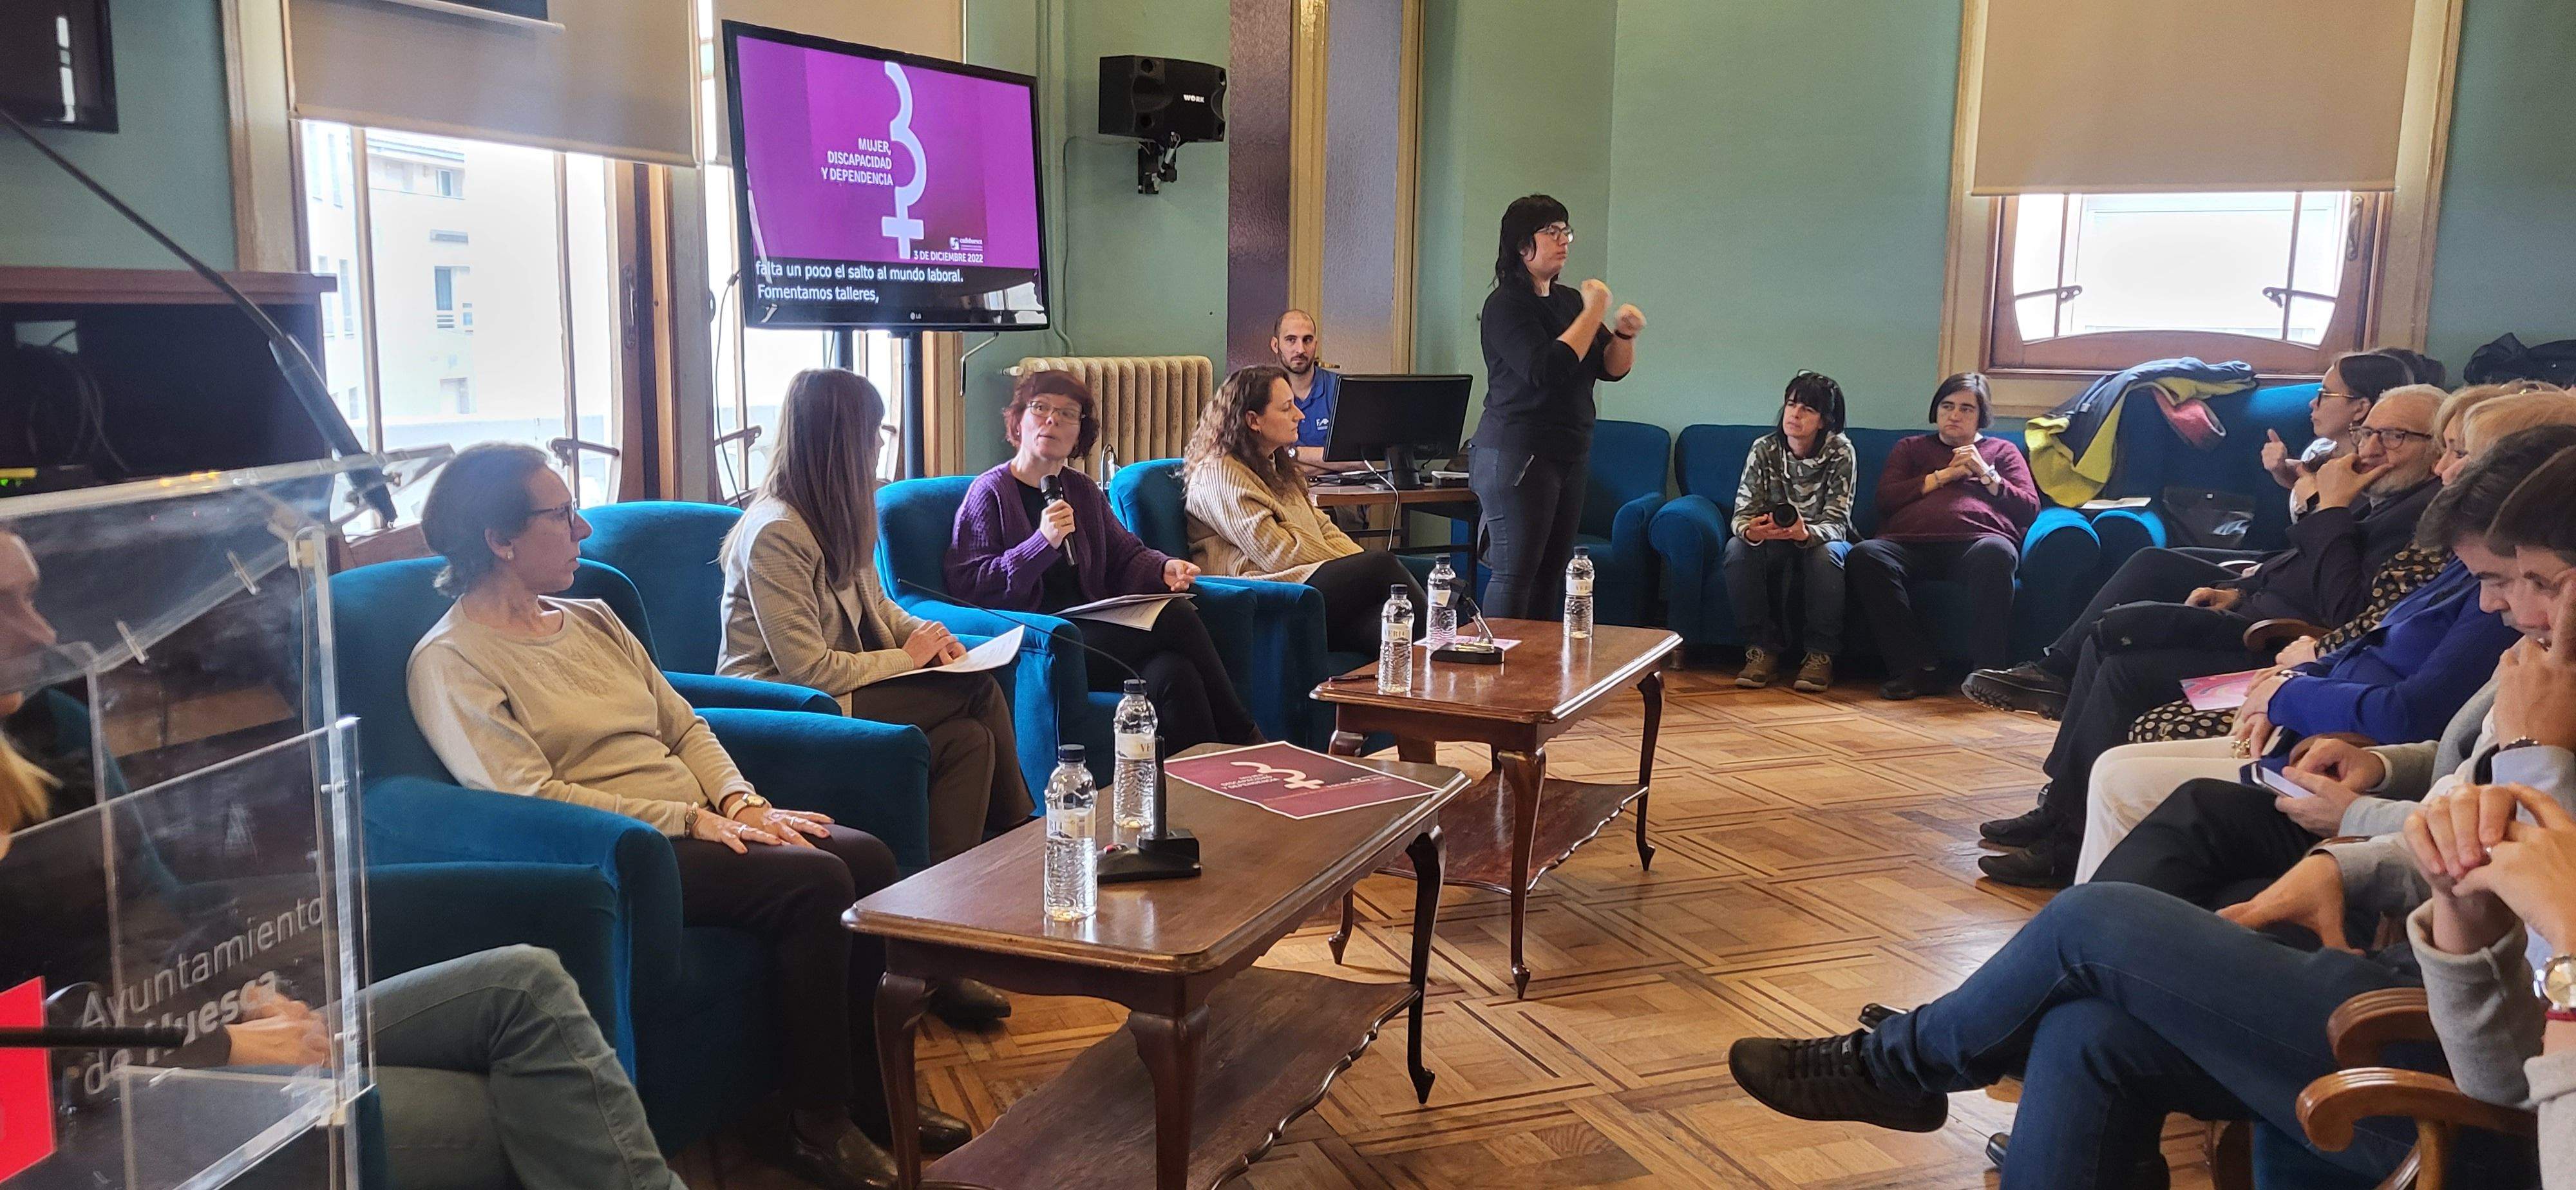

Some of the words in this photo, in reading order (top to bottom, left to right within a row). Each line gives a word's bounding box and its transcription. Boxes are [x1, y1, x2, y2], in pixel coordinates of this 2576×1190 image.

[1183, 94, 1205, 103] WORK
[858, 138, 891, 155] MUJER,
[828, 151, 893, 169] DISCAPACIDAD
[821, 167, 828, 180] Y
[829, 167, 894, 185] DEPENDENCIA
[913, 250, 918, 260] 3
[920, 250, 929, 260] DE
[931, 251, 967, 262] DICIEMBRE
[967, 254, 984, 263] 2022
[755, 261, 782, 276] falta
[786, 265, 802, 277] un
[806, 265, 832, 281] poco
[835, 264, 845, 278] el
[848, 265, 874, 279] salto
[877, 266, 887, 279] al
[890, 267, 925, 281] mundo
[927, 268, 963, 282] laboral.
[757, 284, 833, 300] Fomentamos
[835, 287, 879, 303] talleres,
[81, 898, 323, 1051] Ayuntamiento
